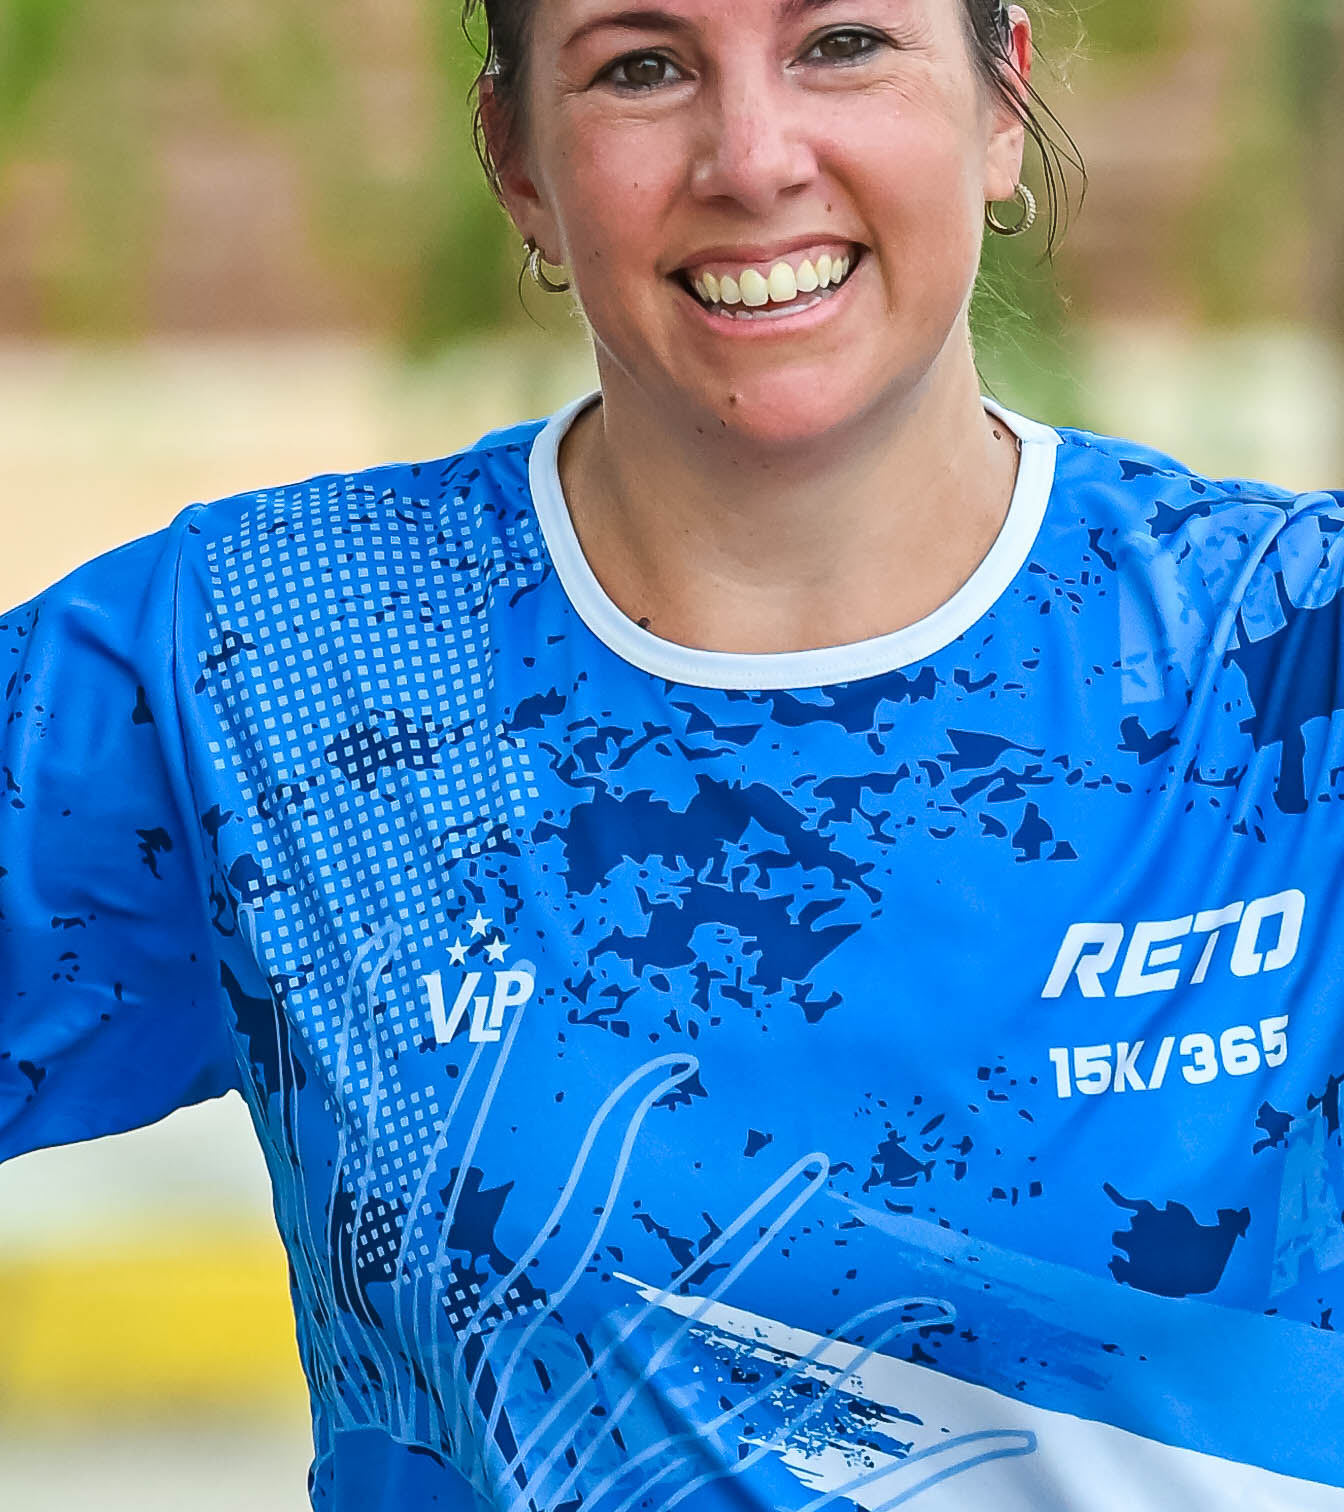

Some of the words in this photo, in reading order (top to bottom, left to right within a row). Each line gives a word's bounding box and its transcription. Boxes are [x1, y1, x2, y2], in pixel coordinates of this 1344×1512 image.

[1040, 888, 1306, 999] RETO
[422, 970, 535, 1044] VLP
[1048, 1014, 1289, 1099] 15K/365
